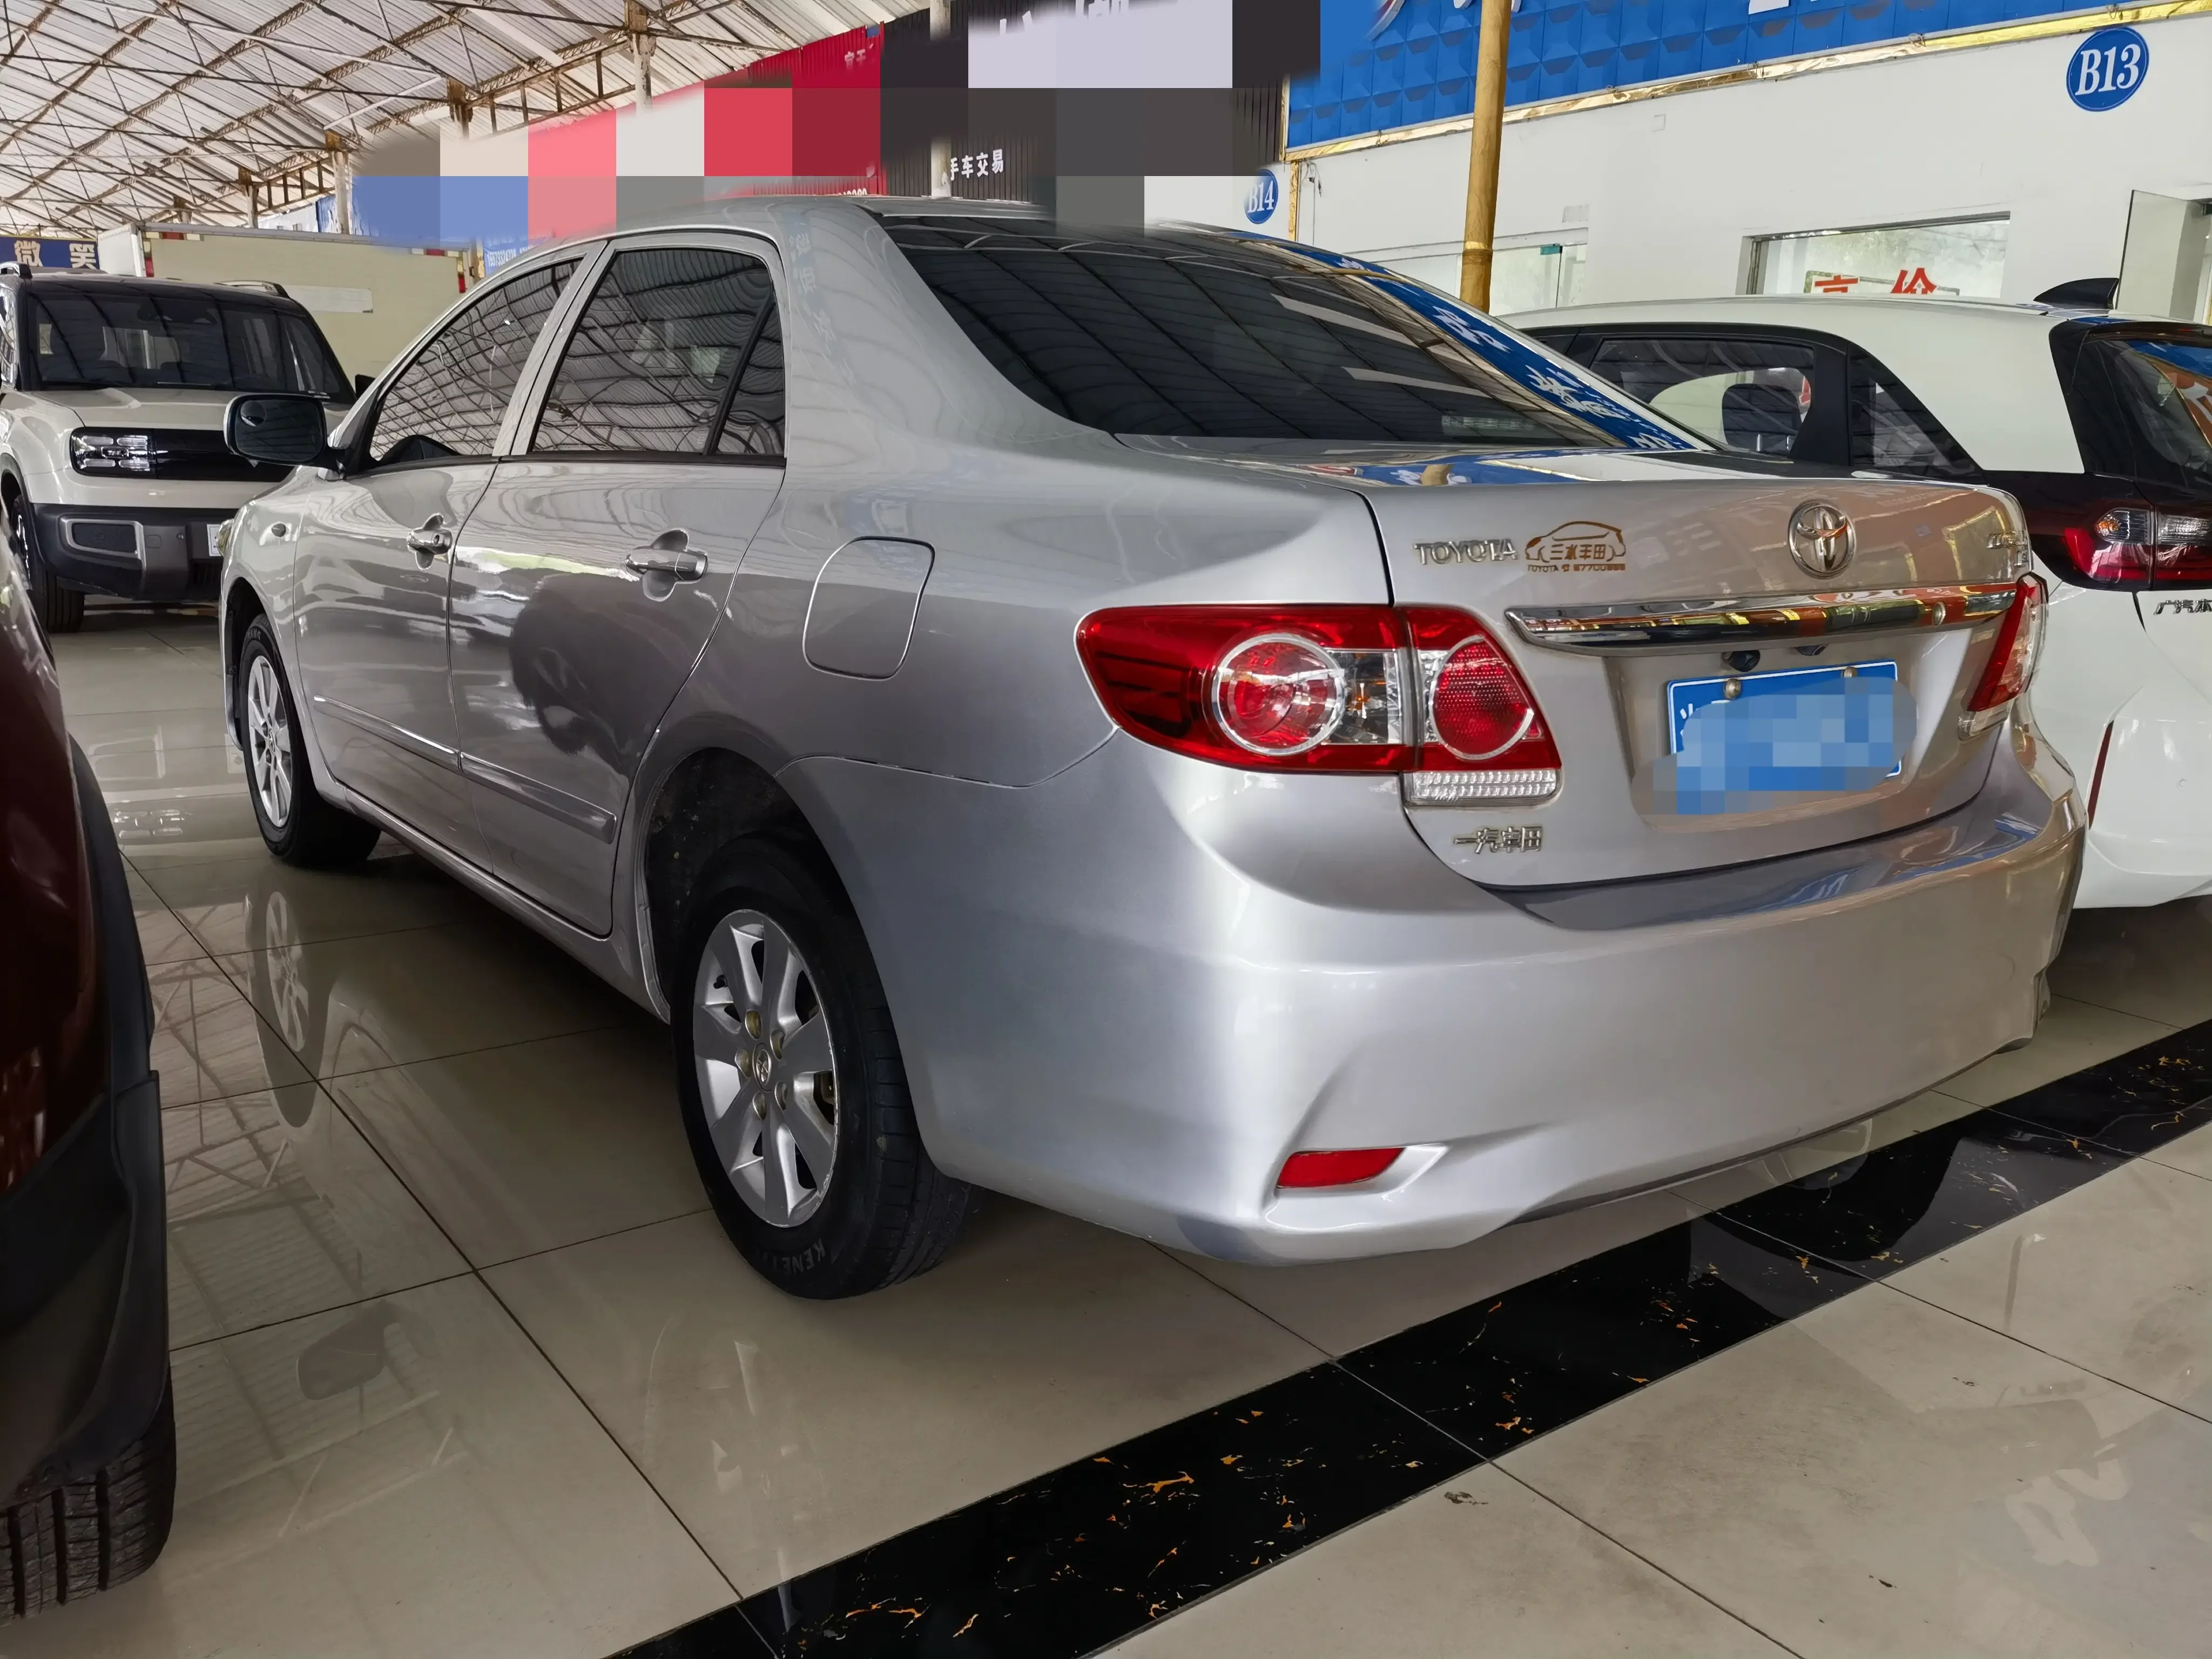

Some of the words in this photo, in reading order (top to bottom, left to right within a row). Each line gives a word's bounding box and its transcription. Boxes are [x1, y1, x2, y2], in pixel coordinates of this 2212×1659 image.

[2075, 44, 2141, 96] B13
[1247, 180, 1274, 213] B14
[14, 240, 99, 270] 微笑
[1412, 538, 1519, 565] TOYOTA
[1453, 826, 1542, 854] 一汽丰田
